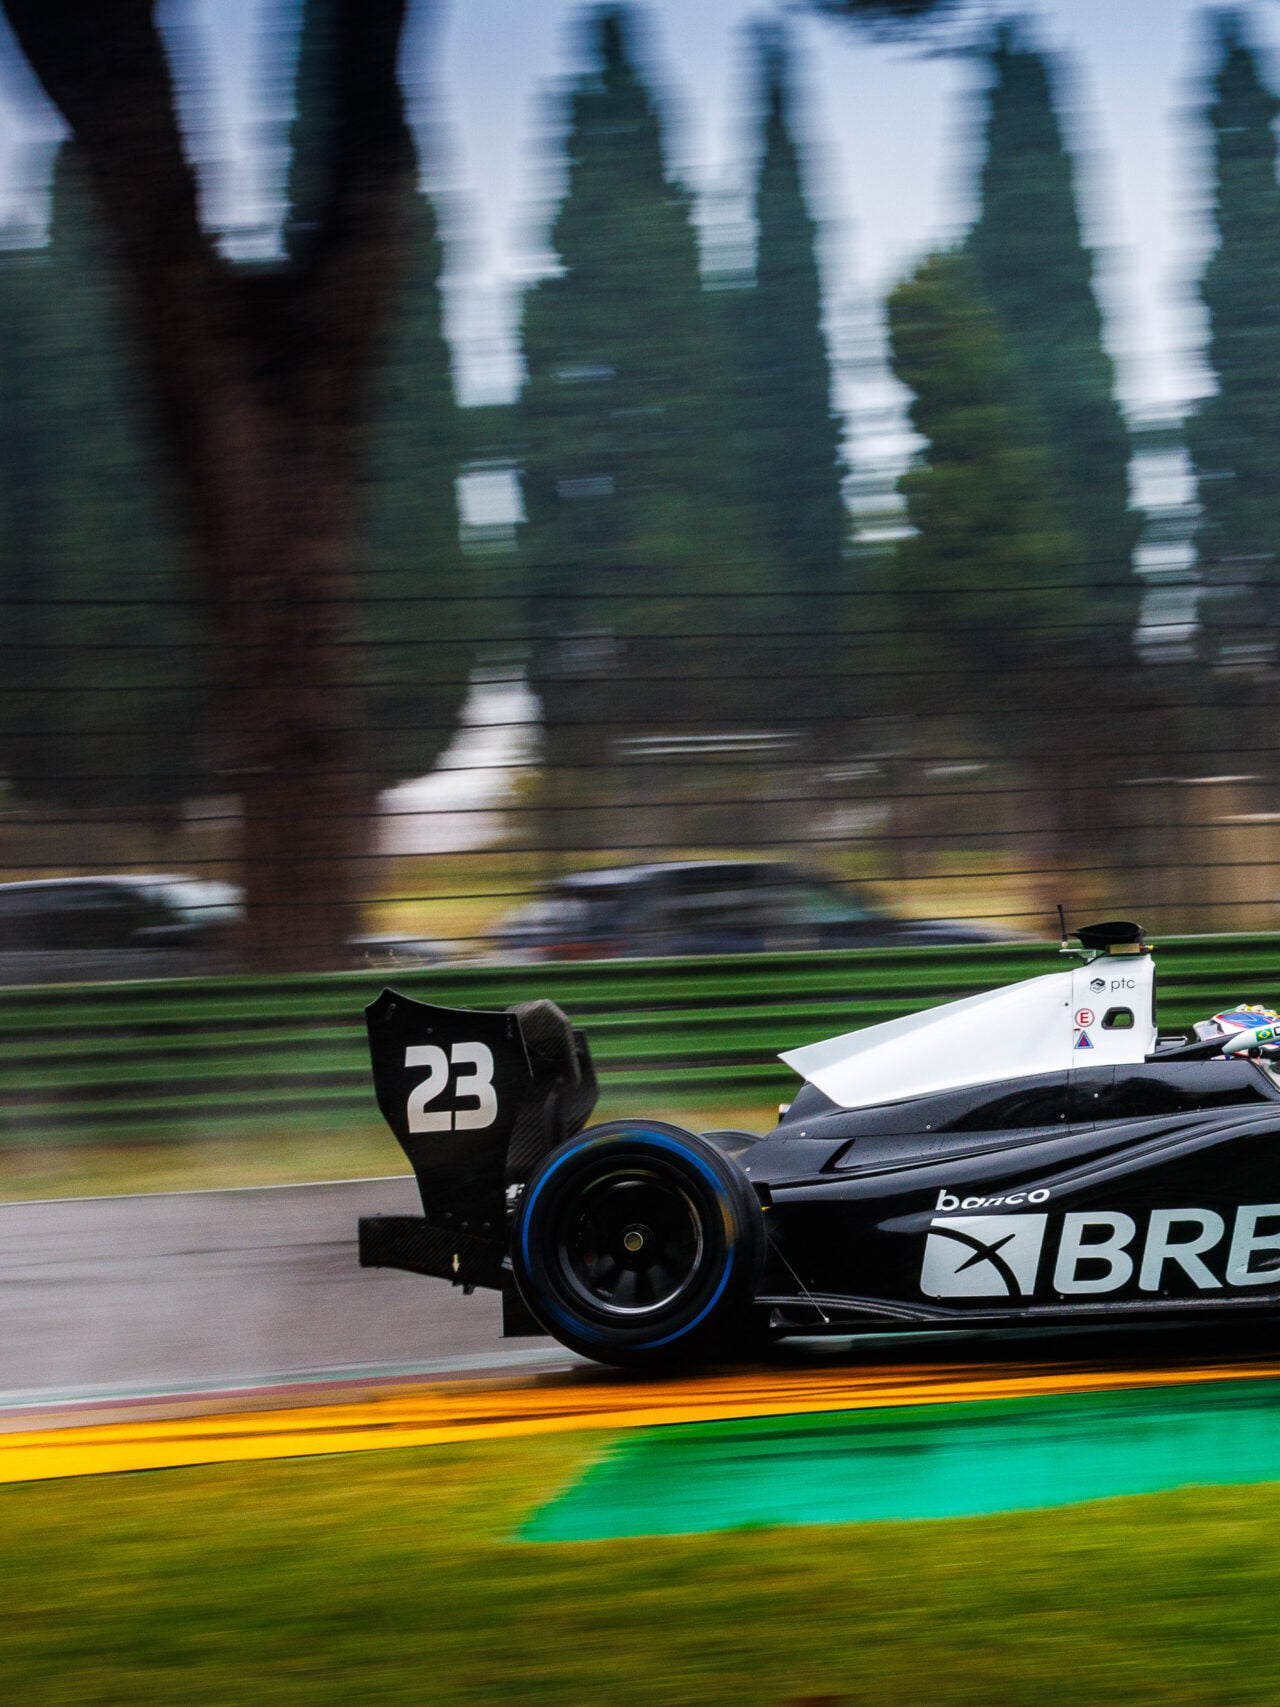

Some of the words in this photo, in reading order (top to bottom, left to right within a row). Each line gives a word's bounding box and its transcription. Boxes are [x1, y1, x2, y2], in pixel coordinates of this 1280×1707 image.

[1111, 977, 1136, 993] ptc
[1080, 1012, 1089, 1024] E
[404, 1041, 498, 1133] 23
[935, 1189, 1051, 1211] banco
